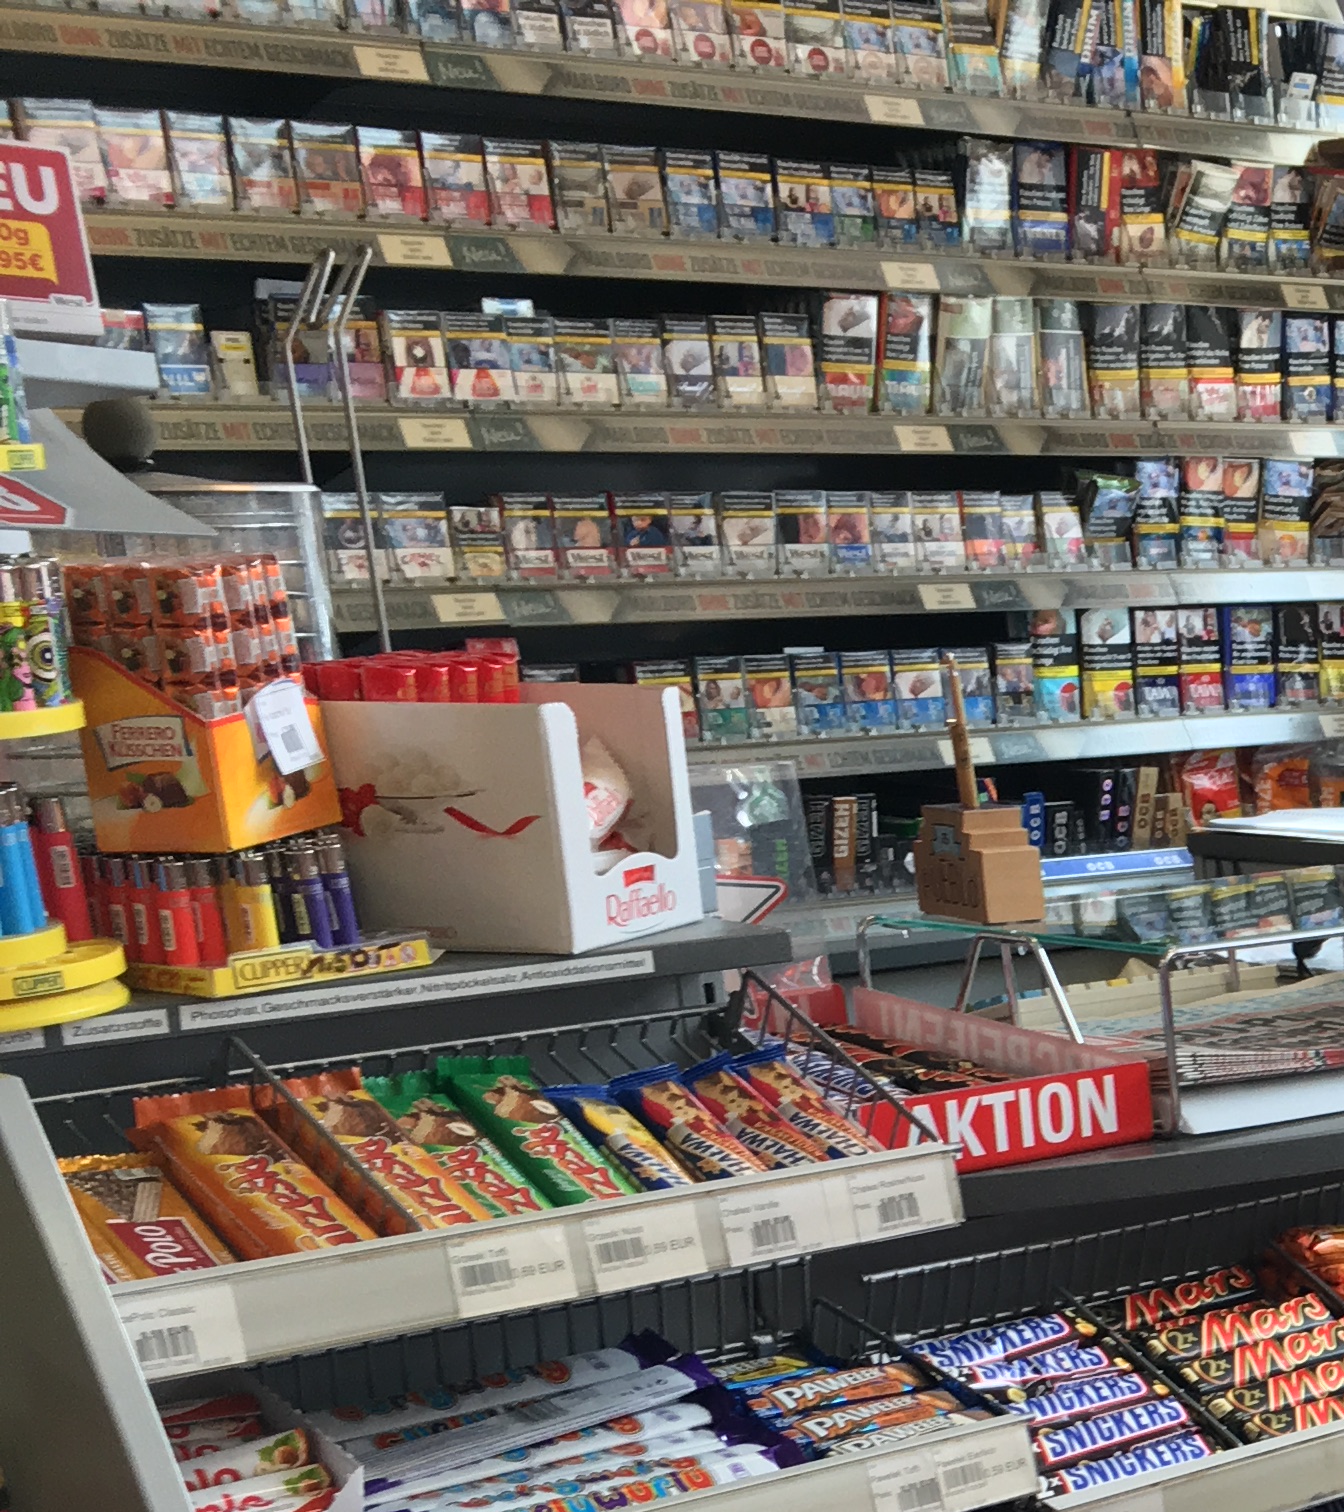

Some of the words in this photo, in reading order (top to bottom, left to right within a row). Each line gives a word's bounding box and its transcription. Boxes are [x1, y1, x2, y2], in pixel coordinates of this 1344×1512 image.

[108, 740, 184, 760] KÜSSCHEN
[111, 724, 174, 744] FERRERO
[606, 887, 678, 926] Raffaello
[73, 1013, 164, 1038] Zusatzstoffe
[907, 1074, 1120, 1160] AKTION
[933, 1314, 1068, 1366] SNICKERS
[1202, 1296, 1329, 1357] Mars
[1046, 1400, 1185, 1455] SNICKERS
